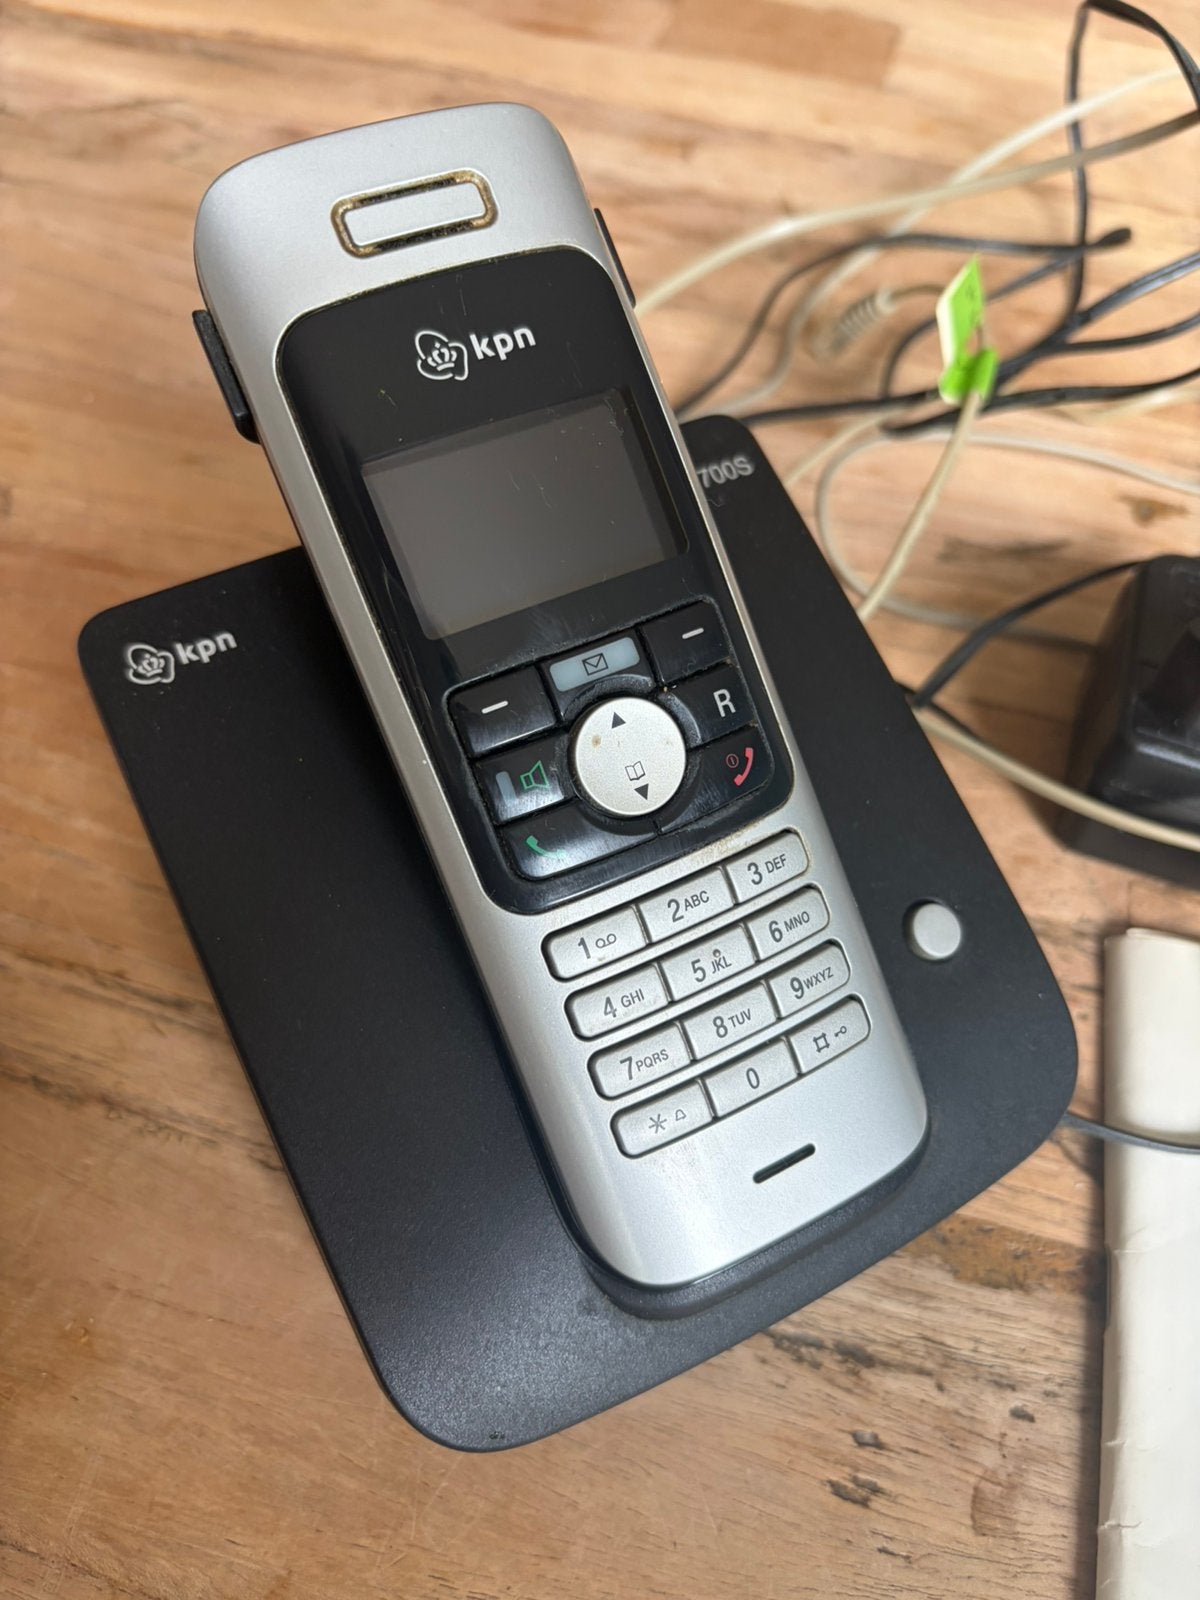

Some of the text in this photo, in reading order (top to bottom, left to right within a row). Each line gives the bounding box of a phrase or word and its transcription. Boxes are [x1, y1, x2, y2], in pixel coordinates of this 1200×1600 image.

[469, 327, 537, 361] kpn
[175, 632, 238, 664] kpn
[713, 688, 736, 718] R
[747, 853, 787, 885] 3 DEF
[667, 890, 710, 922] 2 ABC
[768, 911, 810, 942] 6 MNO
[577, 937, 591, 959] 1
[691, 956, 732, 982] 5 JKL
[790, 967, 834, 1000] 9 WXYZ
[603, 988, 645, 1018] 4 GHI
[712, 1008, 752, 1038] 8 TUV
[620, 1049, 669, 1080] 7 PQRS
[745, 1067, 760, 1089] 0
